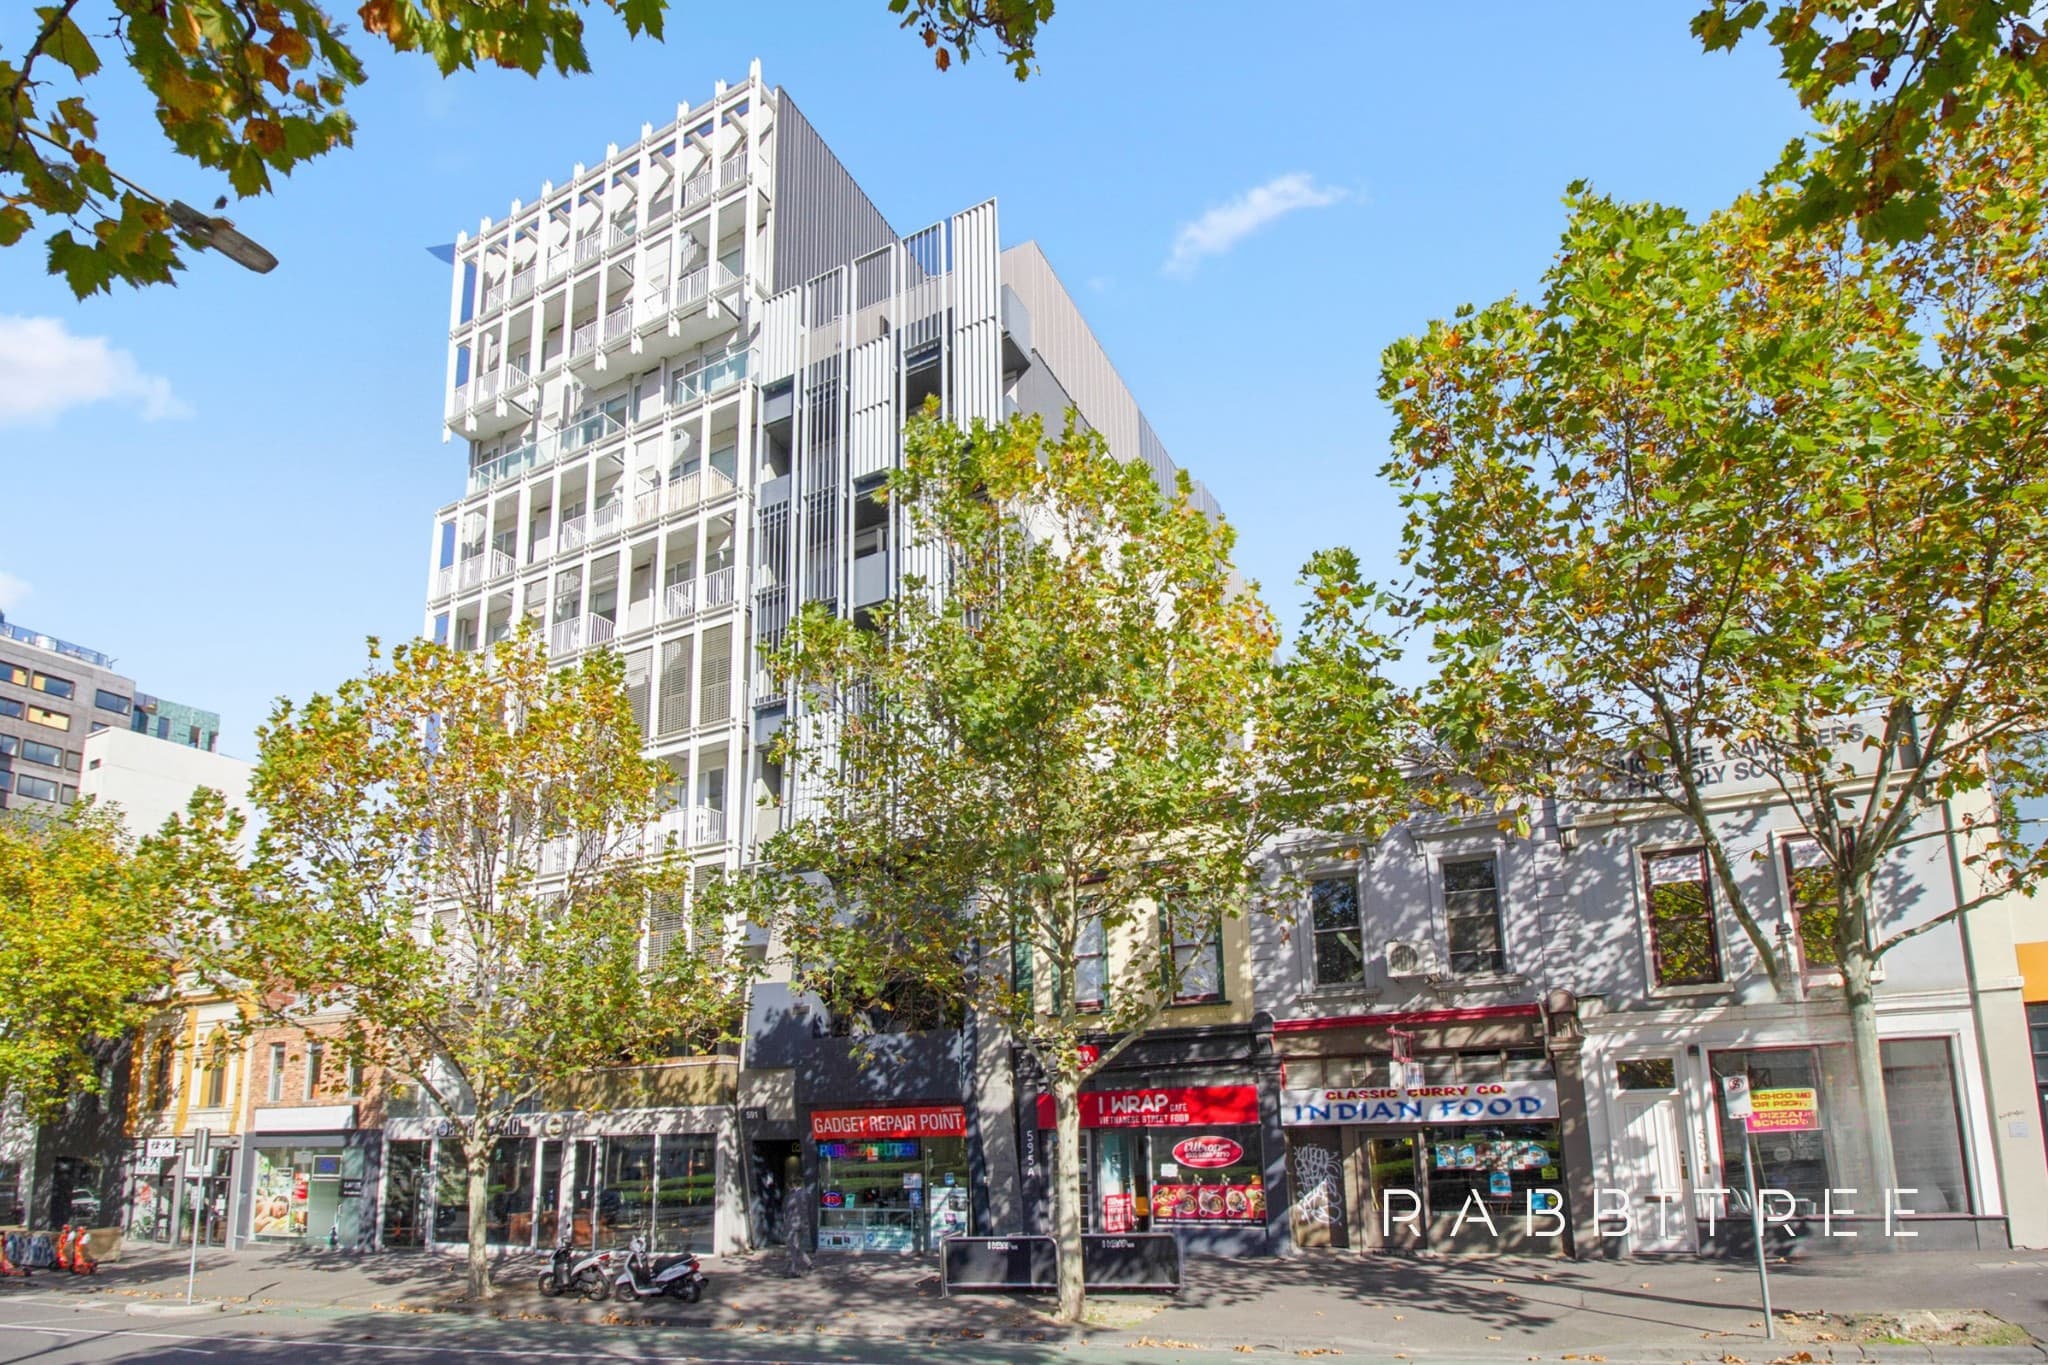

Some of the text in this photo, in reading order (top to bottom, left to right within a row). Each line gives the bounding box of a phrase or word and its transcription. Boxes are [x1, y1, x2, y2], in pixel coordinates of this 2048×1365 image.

[1325, 1084, 1506, 1101] CLASSIC CURRY CO.
[1098, 1096, 1104, 1114] I
[1111, 1094, 1169, 1113] WRAP
[1295, 1096, 1543, 1121] INDIAN FOOD
[745, 1110, 758, 1119] 591
[813, 1112, 963, 1134] GADGET REPAIR POINT
[1141, 1114, 1168, 1124] STREET
[1170, 1113, 1190, 1123] FOOD
